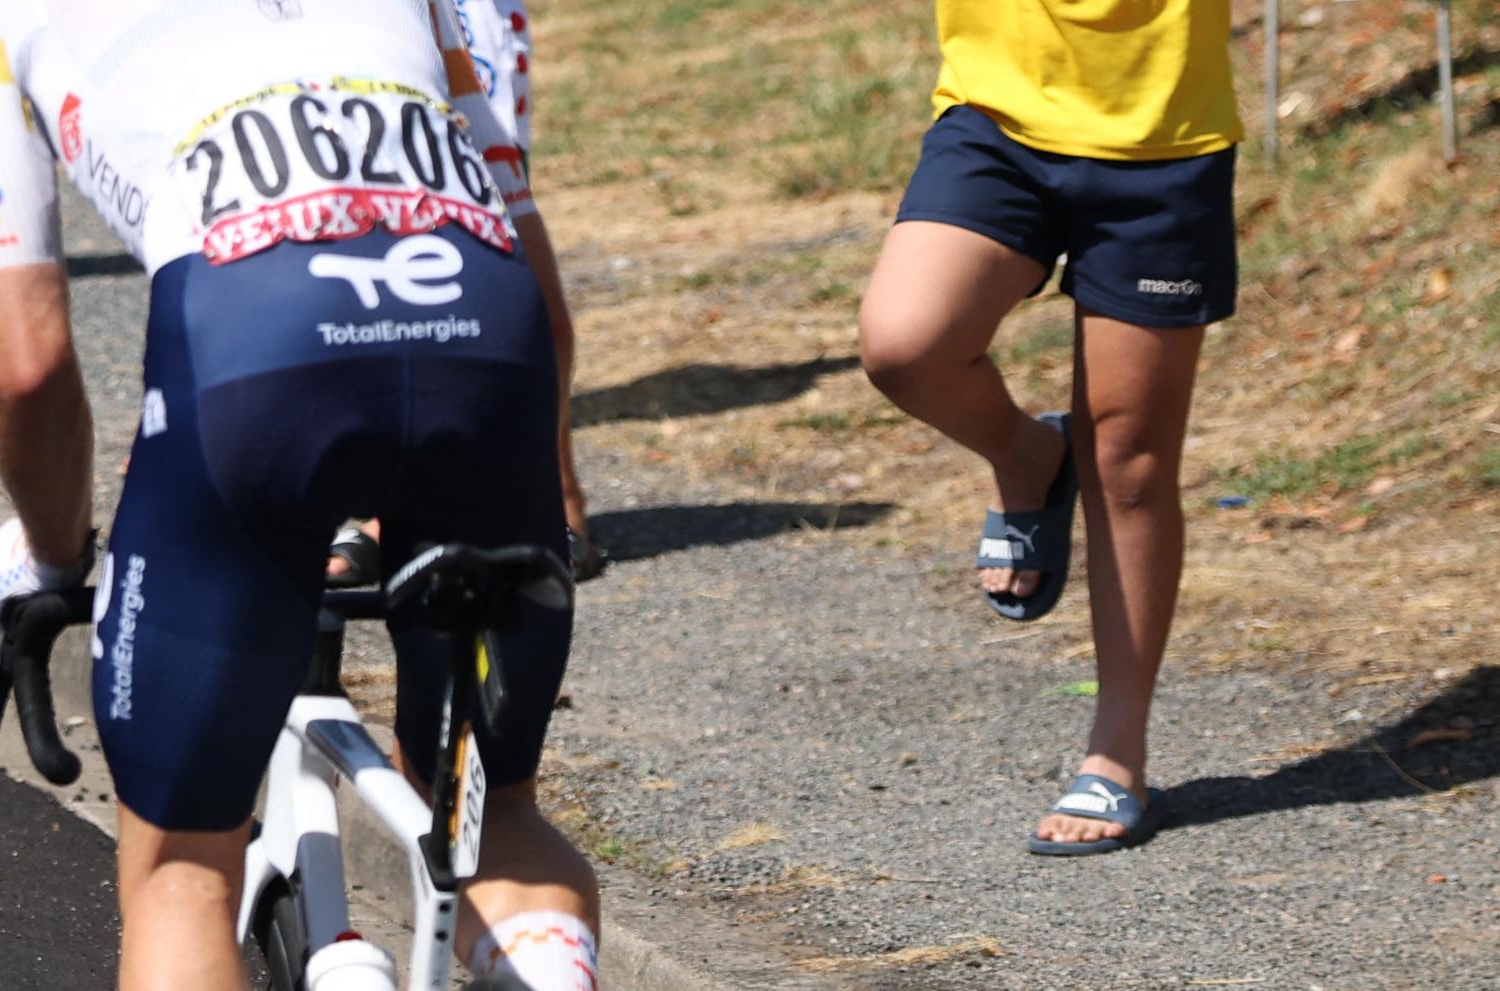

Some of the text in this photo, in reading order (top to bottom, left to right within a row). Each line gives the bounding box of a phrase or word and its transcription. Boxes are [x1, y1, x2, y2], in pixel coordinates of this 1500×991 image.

[186, 95, 351, 227] 206
[341, 97, 492, 206] 206
[316, 313, 482, 346] TotalEnergies
[1137, 278, 1203, 297] macron
[109, 552, 147, 721] TotalEnergies
